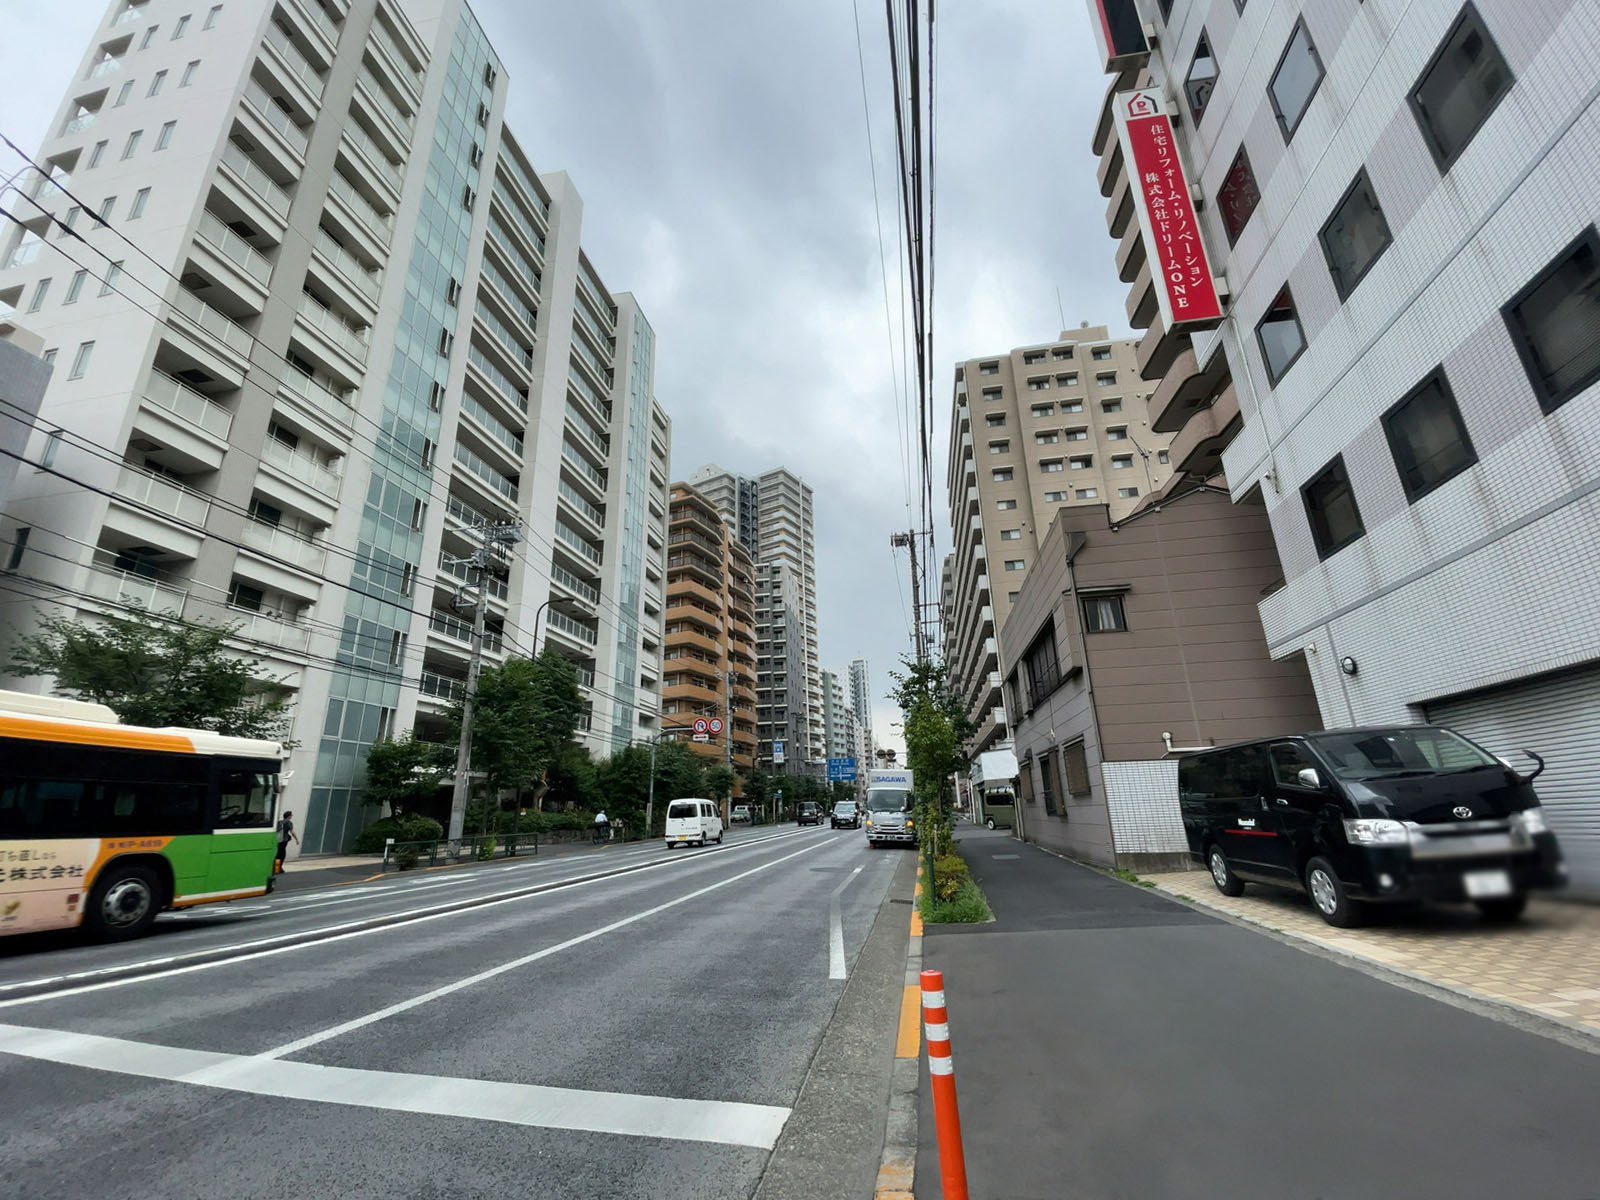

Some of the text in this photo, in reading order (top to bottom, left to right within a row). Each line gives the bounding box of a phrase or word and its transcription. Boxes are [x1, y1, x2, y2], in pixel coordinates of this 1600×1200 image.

[1144, 172, 1190, 308] 株式会社ドリームONE
[1150, 124, 1204, 288] 住宅リフォーム・リノベーション
[711, 721, 721, 730] 50
